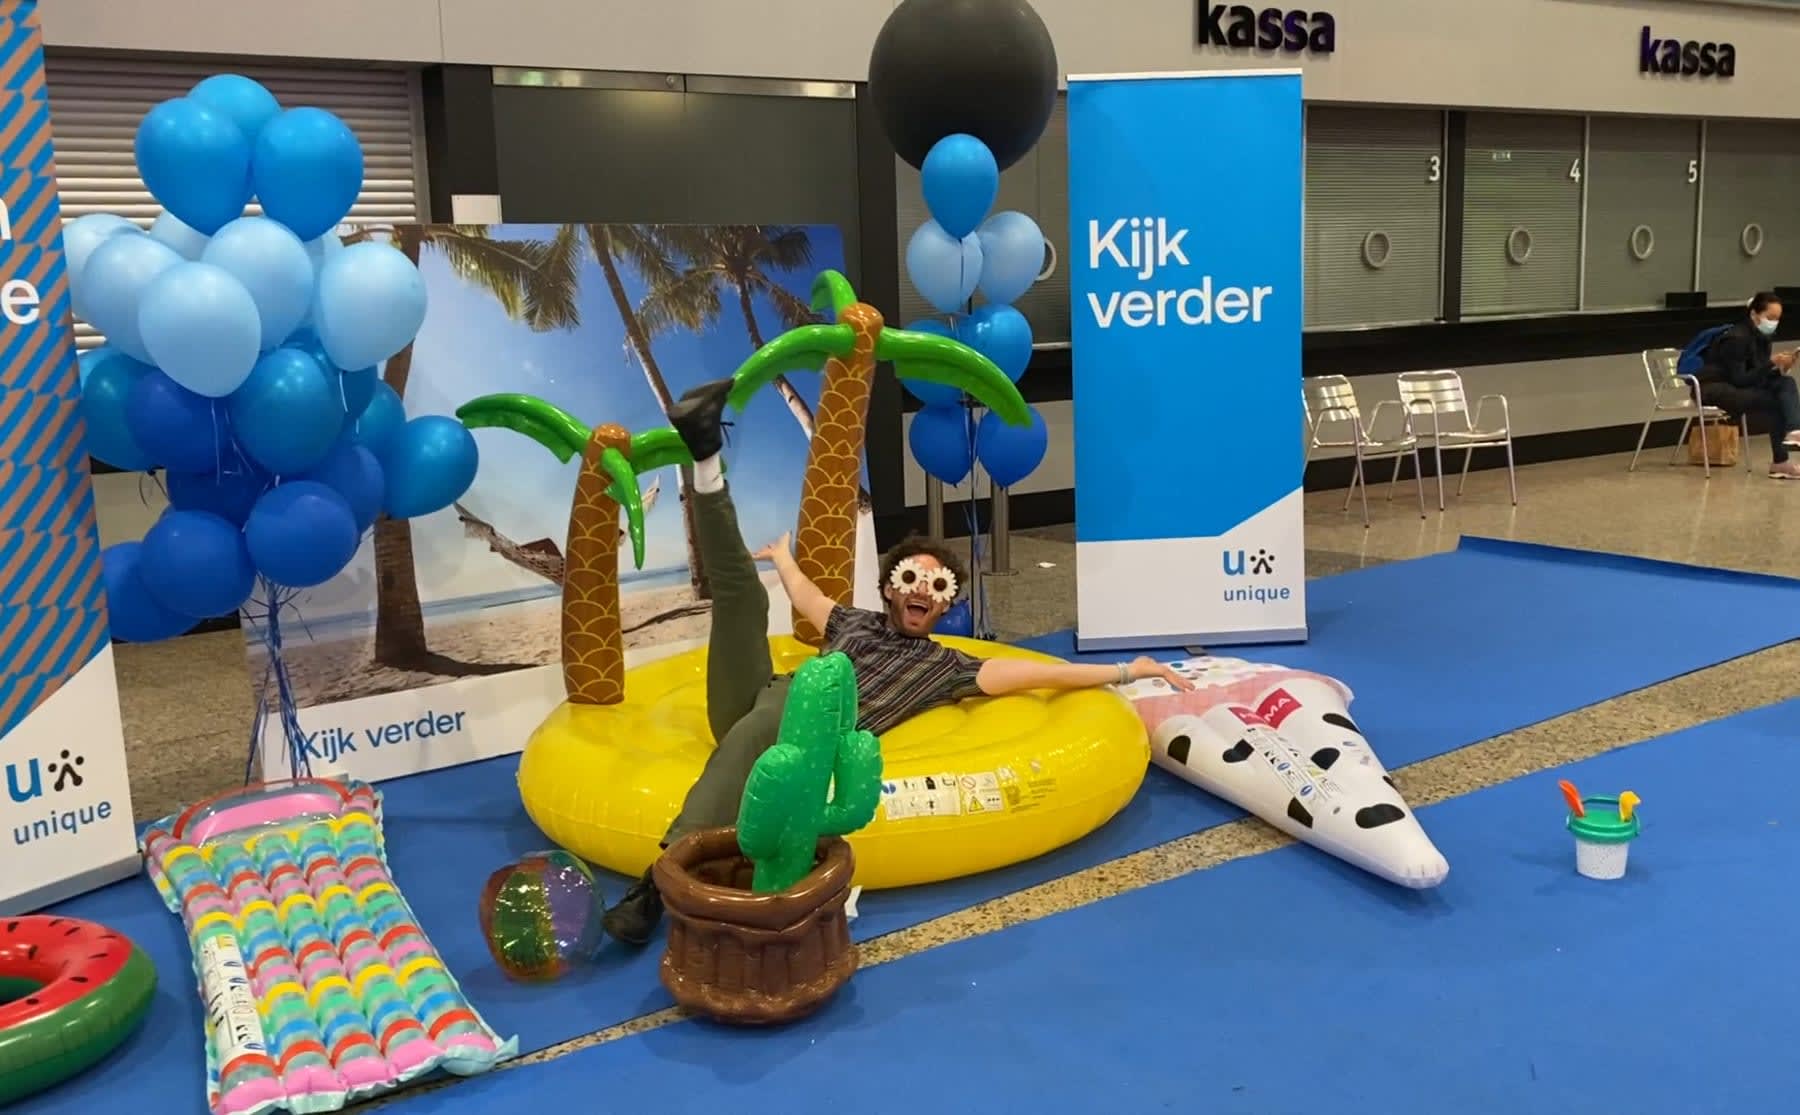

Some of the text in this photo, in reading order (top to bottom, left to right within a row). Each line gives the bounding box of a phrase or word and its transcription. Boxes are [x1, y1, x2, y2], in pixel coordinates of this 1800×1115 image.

[1198, 0, 1335, 53] kassa
[1640, 26, 1735, 77] kassa
[1429, 156, 1441, 182] 3
[1569, 159, 1581, 183] 4
[1688, 160, 1698, 183] 5
[1088, 217, 1190, 281] Kijk
[1087, 275, 1273, 329] verder
[1224, 585, 1290, 604] unique
[301, 710, 466, 763] Kijk verder
[13, 801, 112, 845] unique
